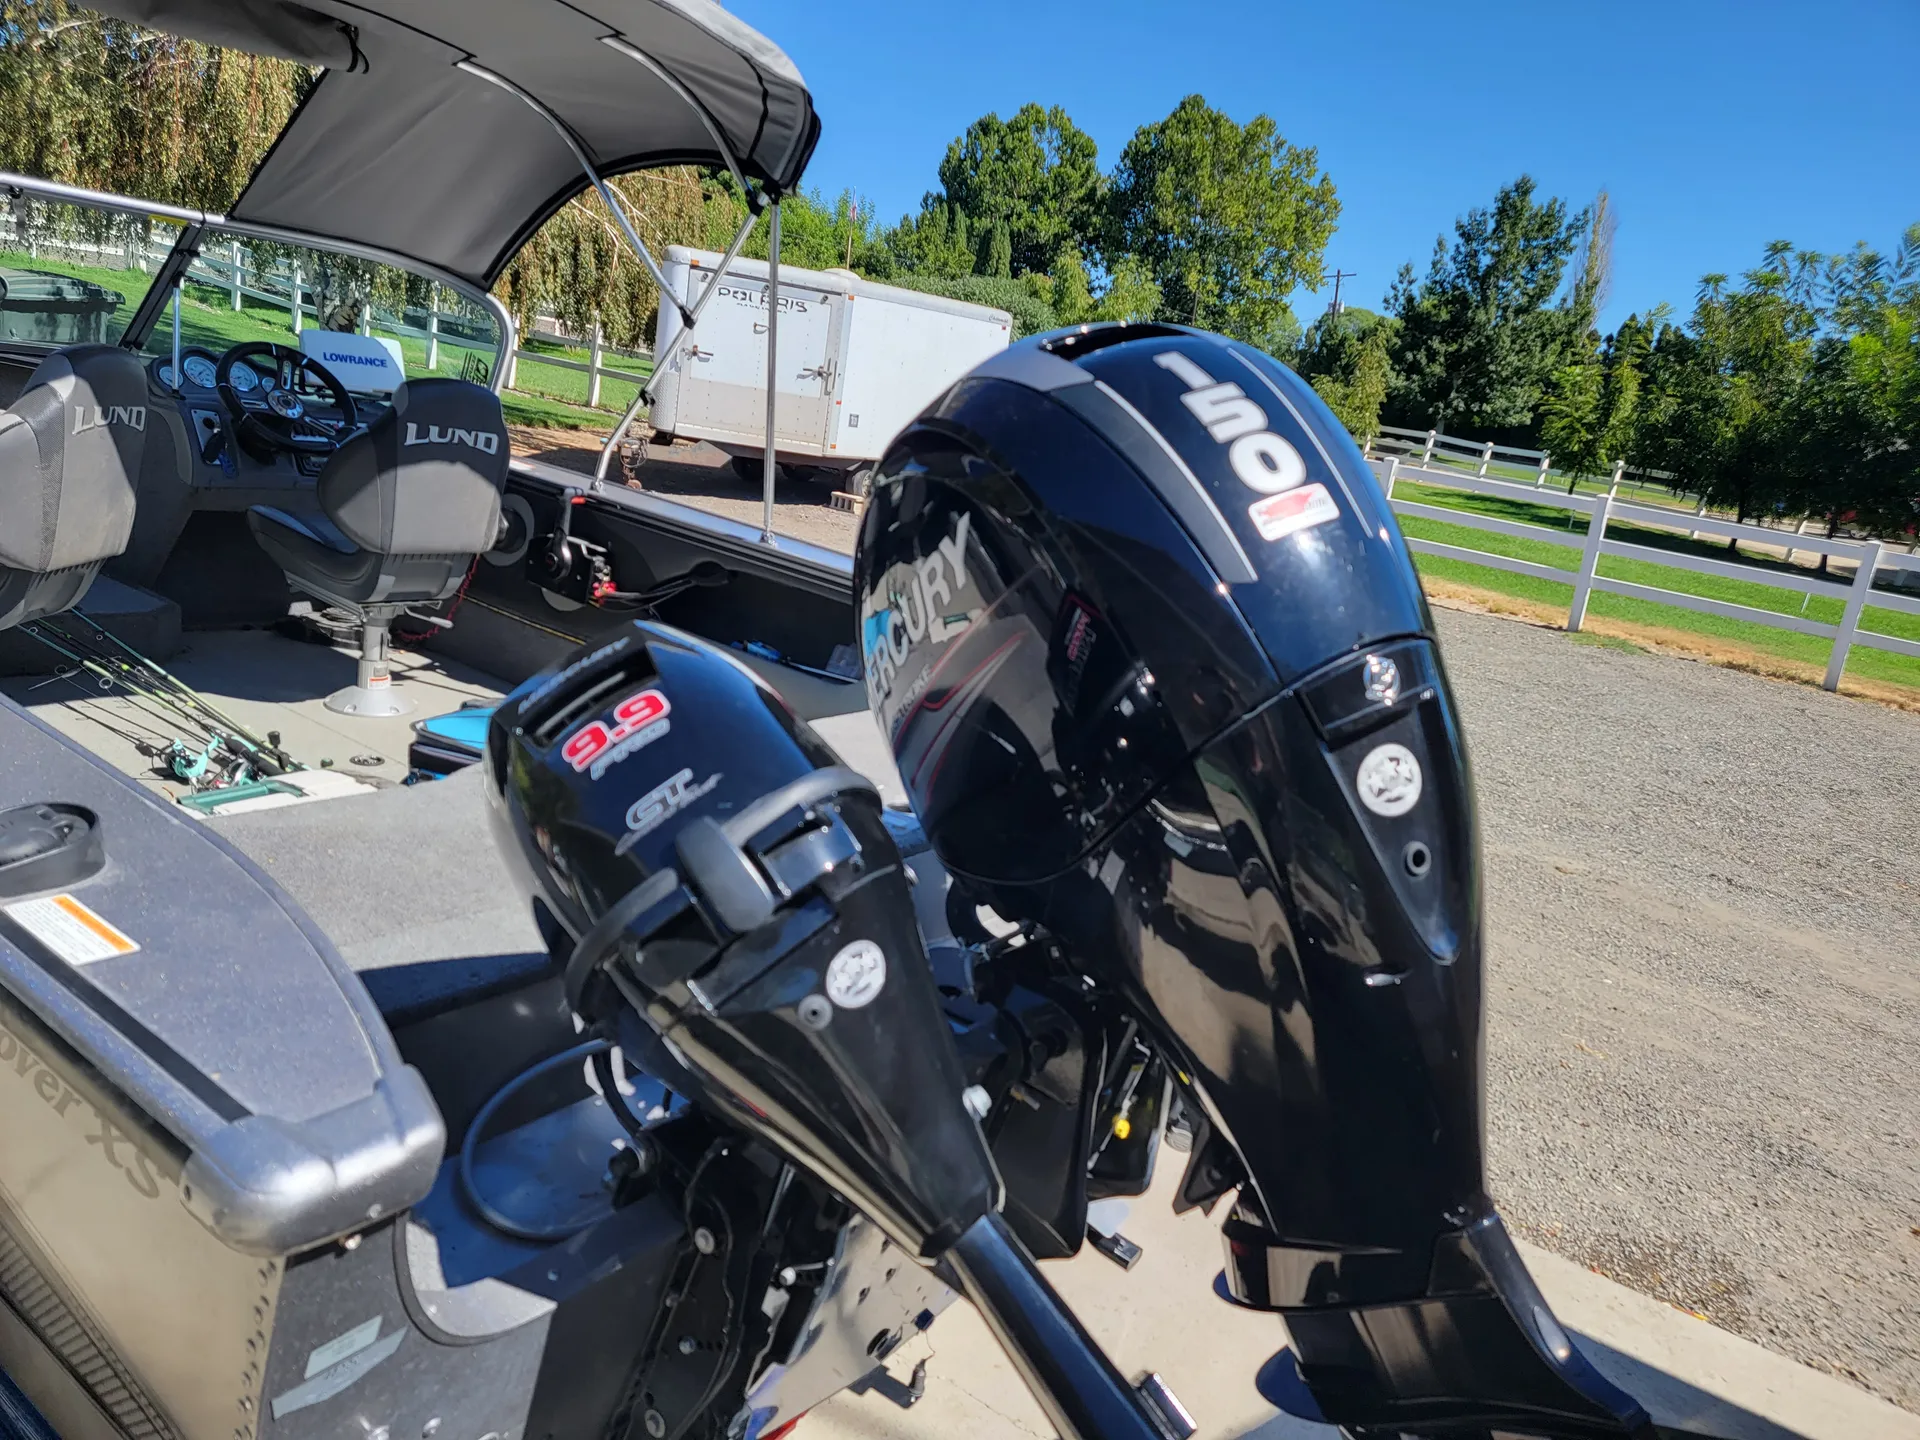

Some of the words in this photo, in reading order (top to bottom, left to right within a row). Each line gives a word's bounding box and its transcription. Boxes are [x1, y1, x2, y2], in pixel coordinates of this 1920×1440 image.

[717, 287, 808, 313] POLARIS
[322, 351, 388, 368] LOWRANCE
[71, 405, 146, 435] LUND
[1153, 350, 1307, 495] 150
[404, 422, 499, 455] LUND
[561, 688, 671, 773] 9.9
